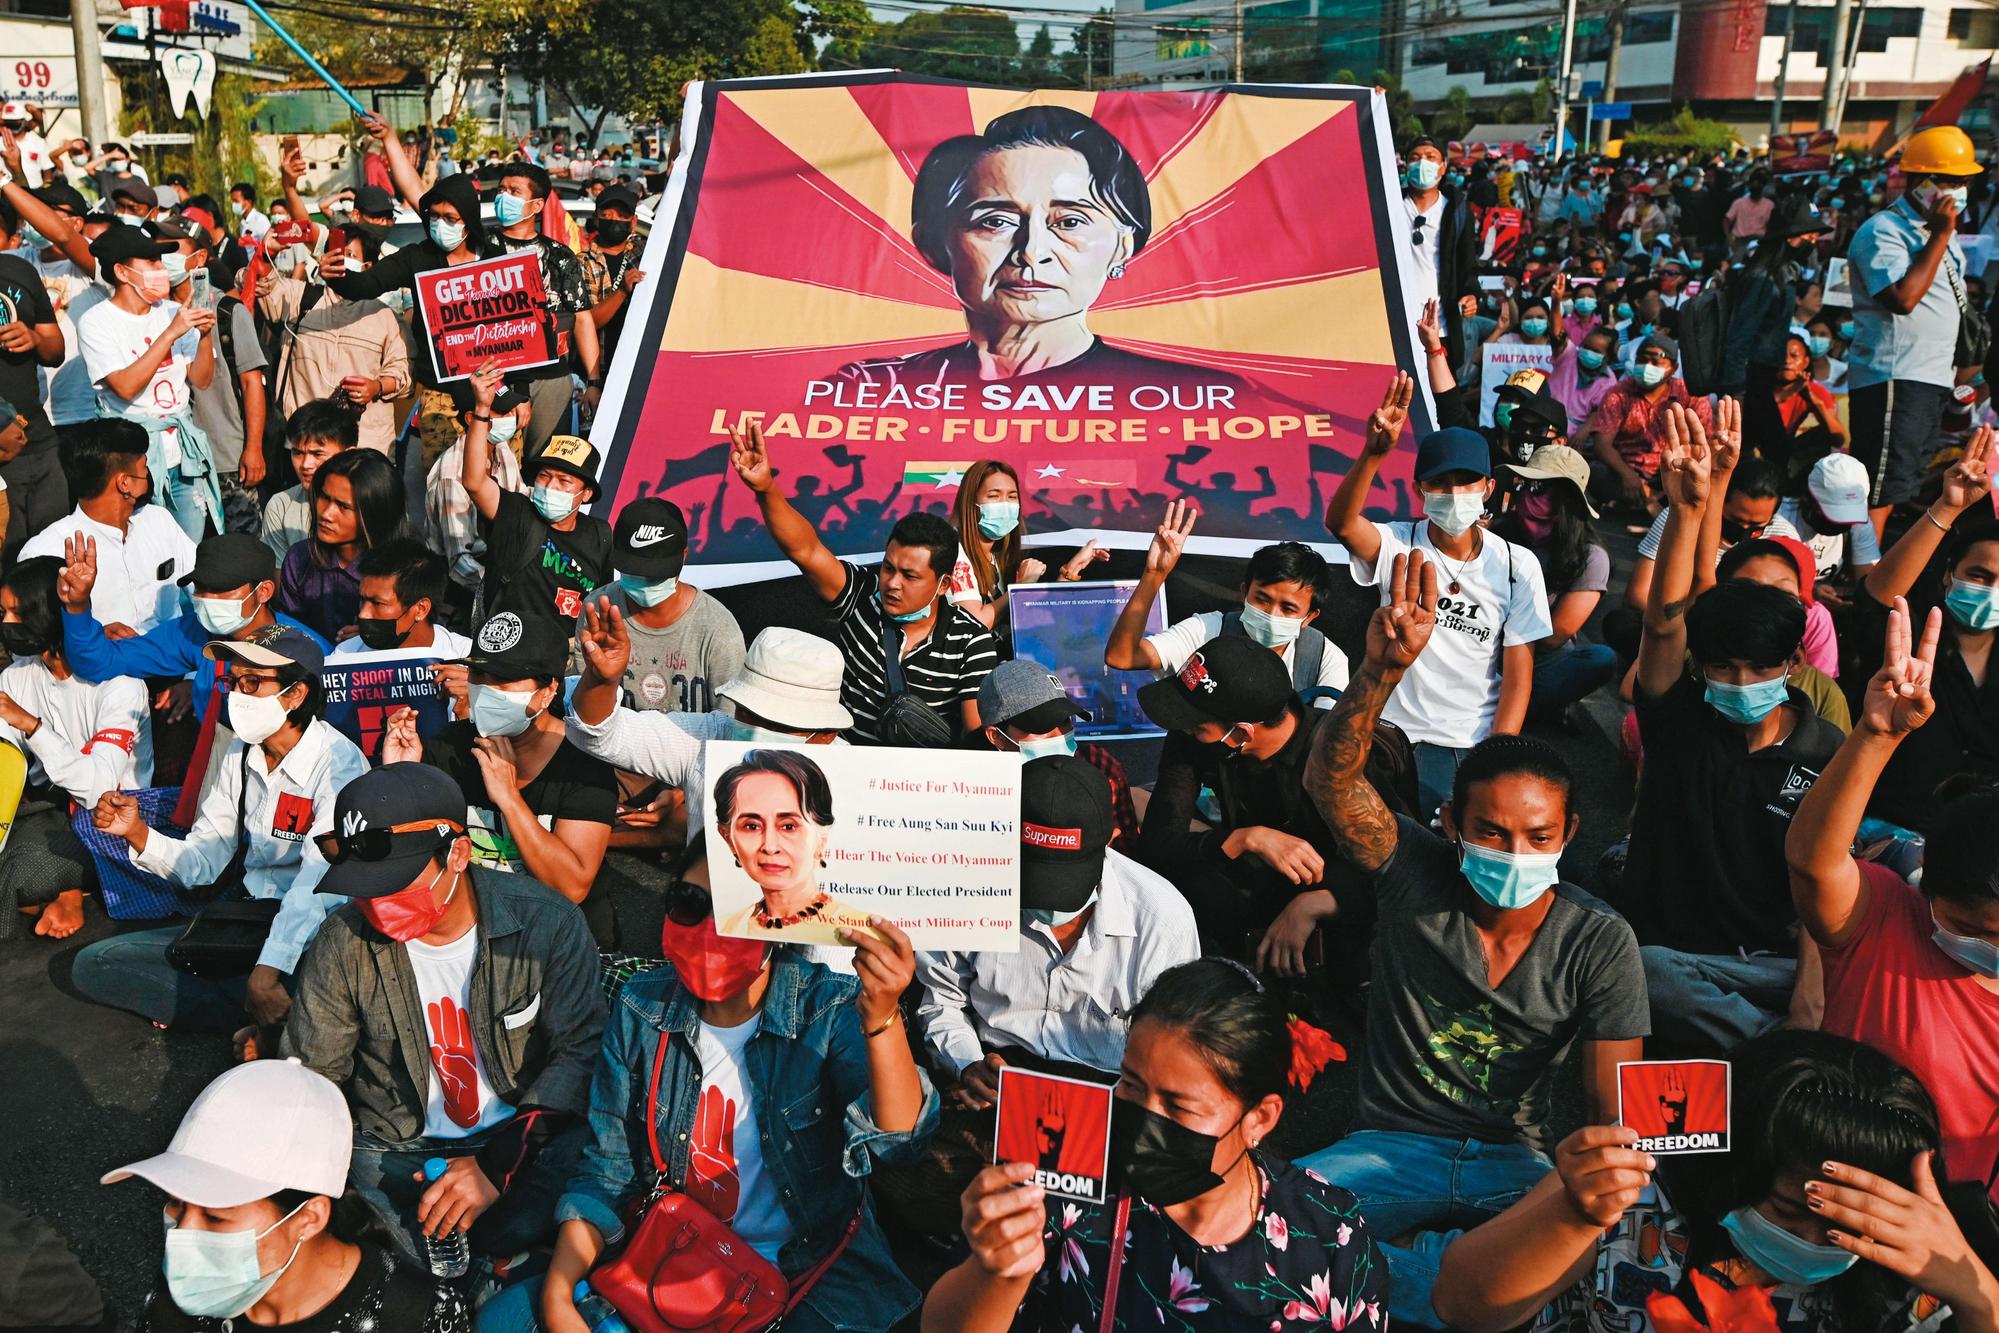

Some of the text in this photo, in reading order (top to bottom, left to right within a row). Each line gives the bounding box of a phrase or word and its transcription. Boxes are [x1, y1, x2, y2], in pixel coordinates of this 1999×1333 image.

[15, 61, 51, 88] 99
[435, 264, 524, 303] GET OUT
[440, 290, 532, 325] DICTATOR
[445, 320, 537, 346] END THE Dictatorship
[473, 340, 524, 358] MYANMAR
[1491, 353, 1543, 364] MILITARY
[804, 380, 1236, 412] PLEASE SAVE OUR
[709, 408, 1334, 443] LEADER FUTURE HOPE
[635, 524, 664, 540] NIKE
[1437, 597, 1480, 619] 021
[665, 647, 688, 670] USA
[321, 672, 347, 688] HEY
[351, 669, 394, 687] SHOOT
[398, 667, 412, 683] IN
[326, 690, 347, 703] HEY
[351, 687, 388, 701] STEAL
[391, 685, 404, 698] AT
[879, 779, 921, 792] Justice
[926, 780, 947, 793] For
[952, 782, 1013, 798] Myanmar
[273, 828, 306, 841] FREEDO
[868, 815, 895, 827] Free
[899, 817, 932, 832] Aung
[935, 818, 958, 831] San
[962, 819, 986, 832] Suu
[990, 820, 1013, 836] Kyi
[1023, 826, 1078, 845] Supreme.
[835, 848, 865, 861] Hear
[868, 850, 892, 863] The
[895, 851, 928, 864] Voice
[931, 852, 948, 864] Of
[951, 853, 1013, 868] Myanmar
[829, 882, 874, 894] Release
[877, 884, 902, 895] Our
[906, 885, 951, 897] Elected
[955, 885, 1012, 897] President
[816, 913, 835, 925] We
[838, 914, 873, 928] Stand
[926, 917, 976, 930] Military
[979, 917, 1013, 930] Coup
